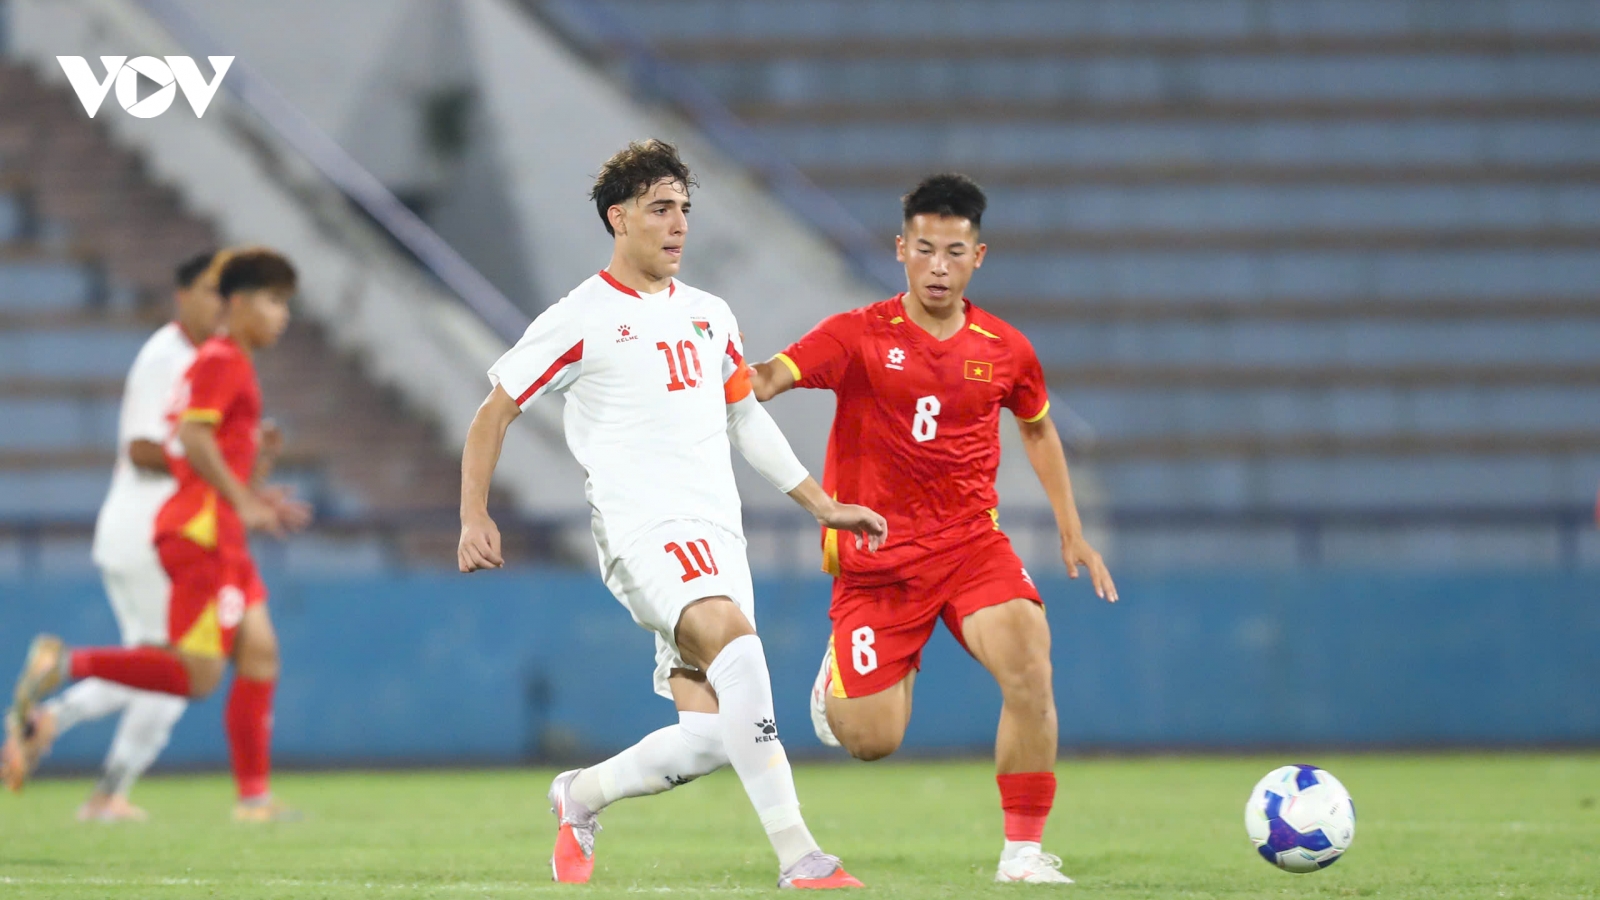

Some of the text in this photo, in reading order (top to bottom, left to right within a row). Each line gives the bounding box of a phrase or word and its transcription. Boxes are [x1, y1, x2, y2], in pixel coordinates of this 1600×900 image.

[616, 335, 638, 343] KELME
[656, 340, 703, 391] 10
[911, 395, 941, 442] 8
[664, 538, 718, 583] 10
[851, 626, 877, 675] 8
